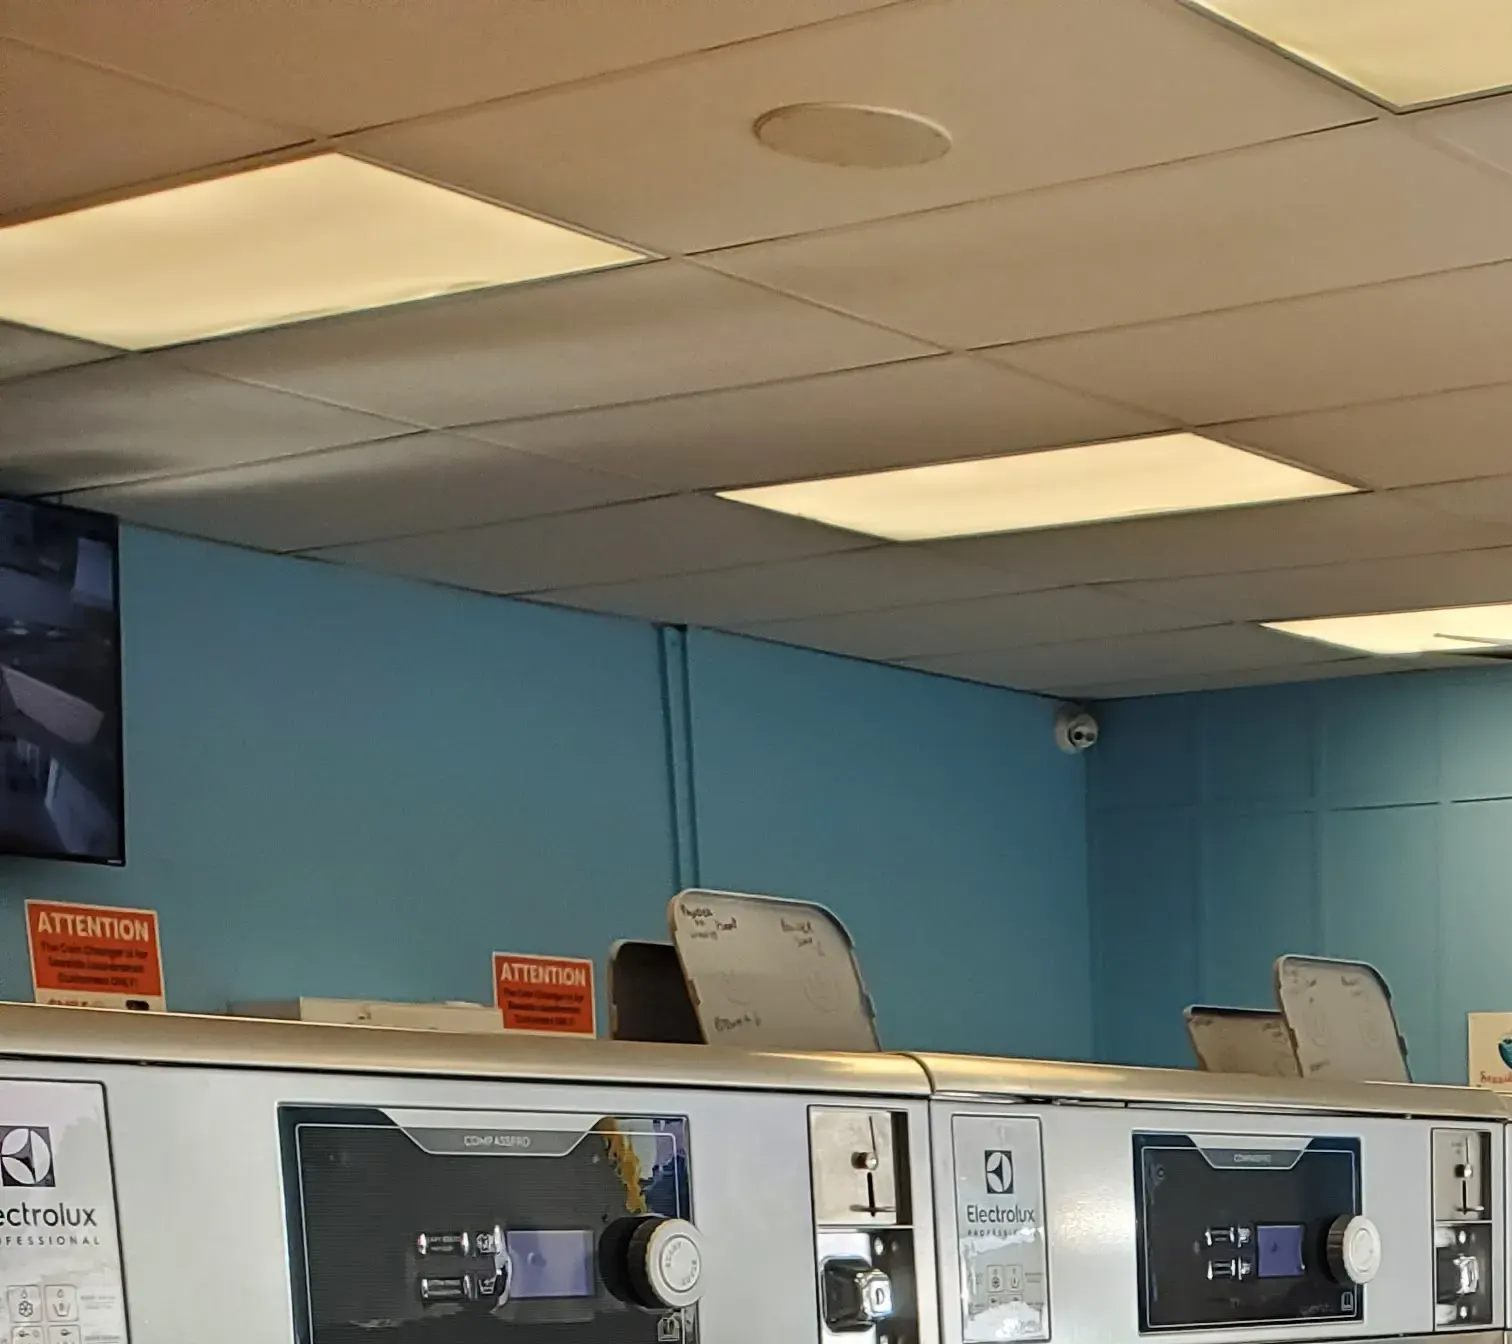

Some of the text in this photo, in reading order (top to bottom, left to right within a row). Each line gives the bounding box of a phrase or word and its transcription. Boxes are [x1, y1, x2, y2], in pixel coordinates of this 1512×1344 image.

[38, 911, 149, 942] ATTENTION
[500, 962, 586, 987] ATTENTION
[967, 1204, 1036, 1223] Electrolux
[0, 1235, 100, 1245] FESSIONAL
